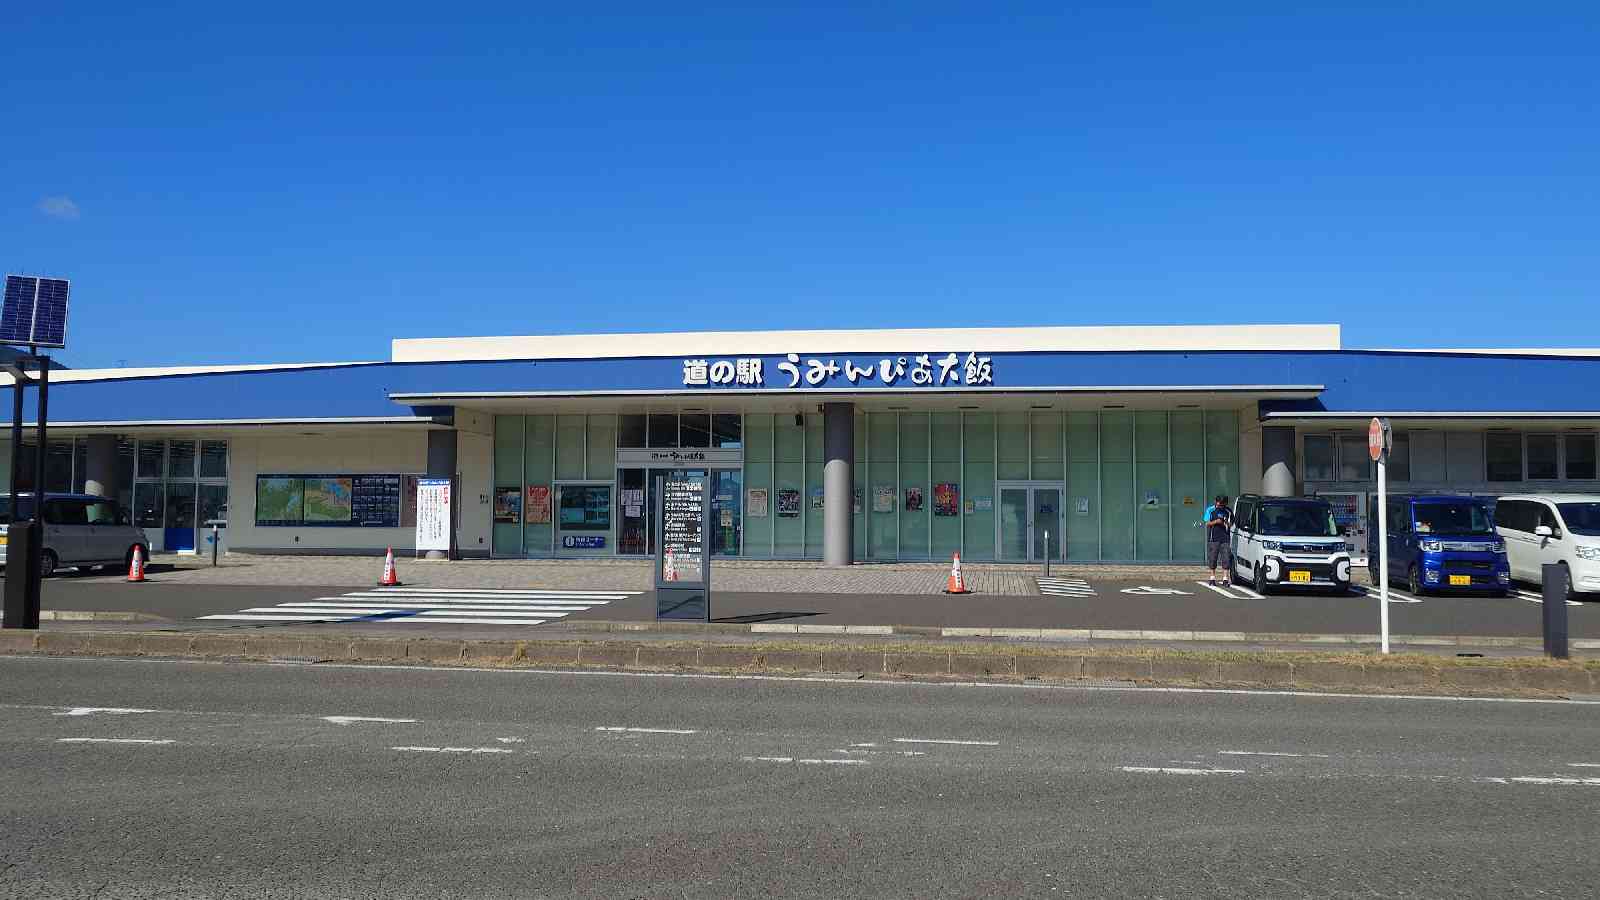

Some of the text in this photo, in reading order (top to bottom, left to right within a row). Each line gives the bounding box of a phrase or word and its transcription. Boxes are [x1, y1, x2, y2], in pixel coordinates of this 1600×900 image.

[683, 353, 993, 387] 道の駅 うみんぴあ大飯
